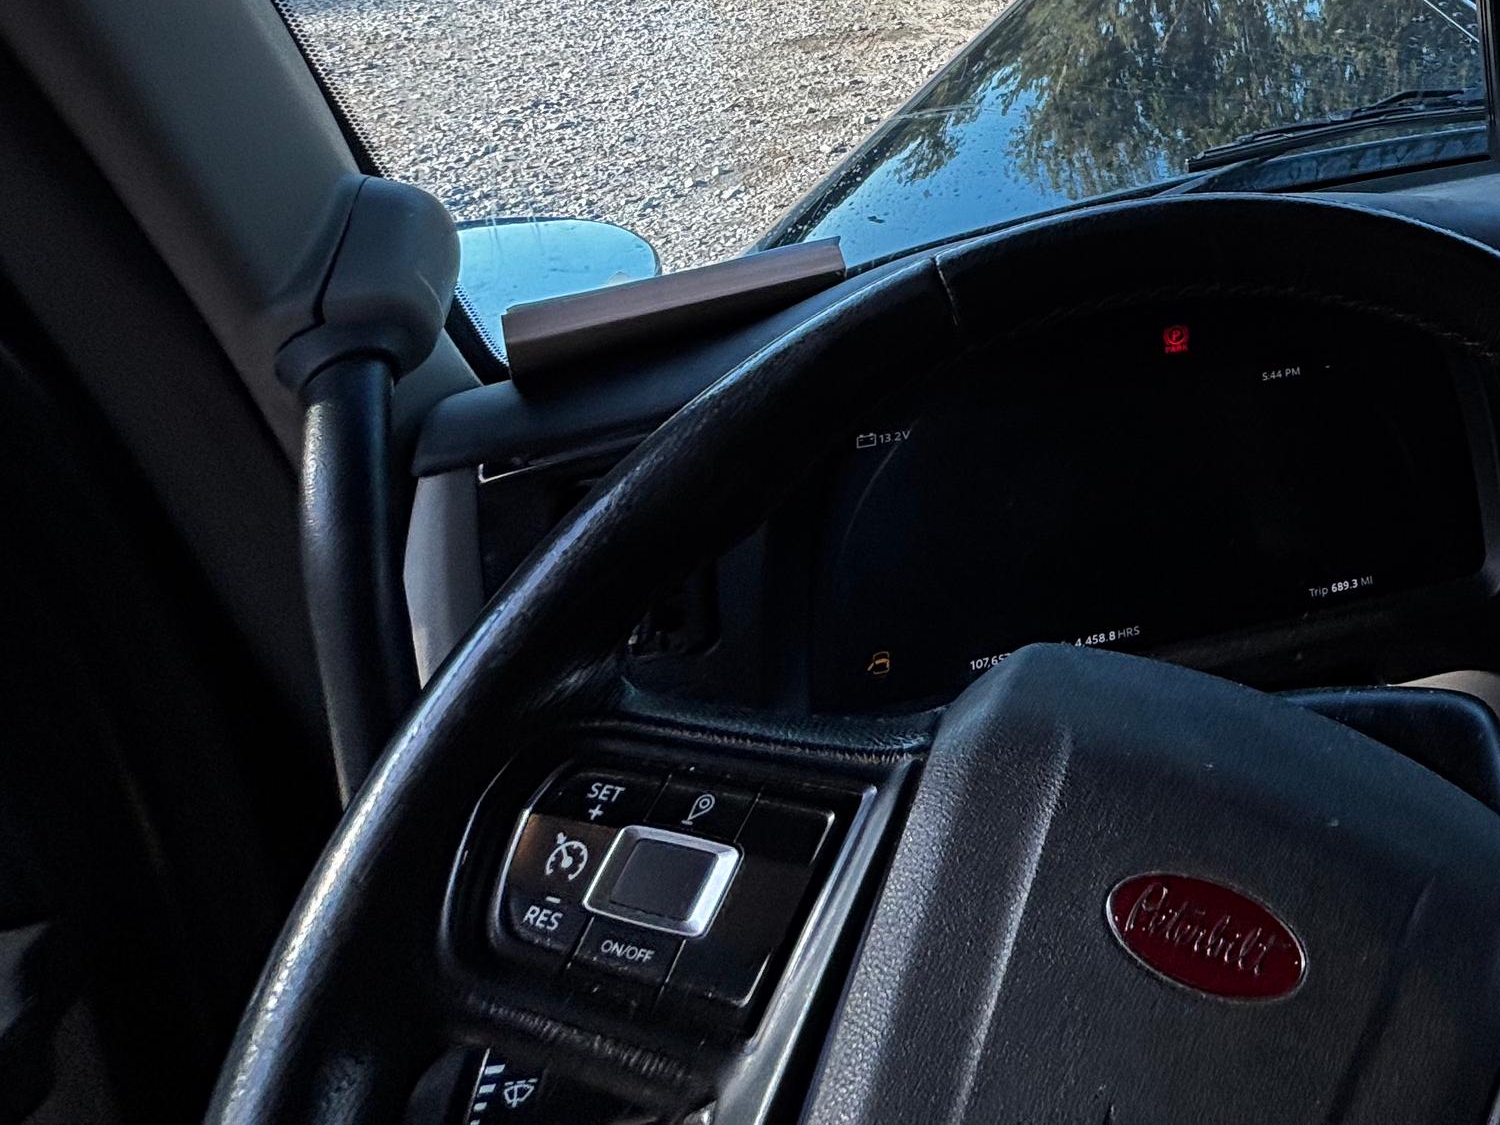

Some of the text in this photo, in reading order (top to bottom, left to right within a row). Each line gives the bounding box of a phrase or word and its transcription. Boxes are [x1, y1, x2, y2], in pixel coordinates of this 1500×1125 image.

[1164, 344, 1189, 354] PARK
[1261, 366, 1301, 381] 5:44 PM
[878, 430, 911, 443] 13.2V
[1308, 575, 1373, 598] Trip 689.3 MI
[1074, 625, 1141, 647] 4,458.8 HRS
[586, 781, 626, 804] SET
[522, 904, 563, 933] RES
[1124, 881, 1278, 977] Peterbilt
[600, 938, 656, 964] ON/OFF
